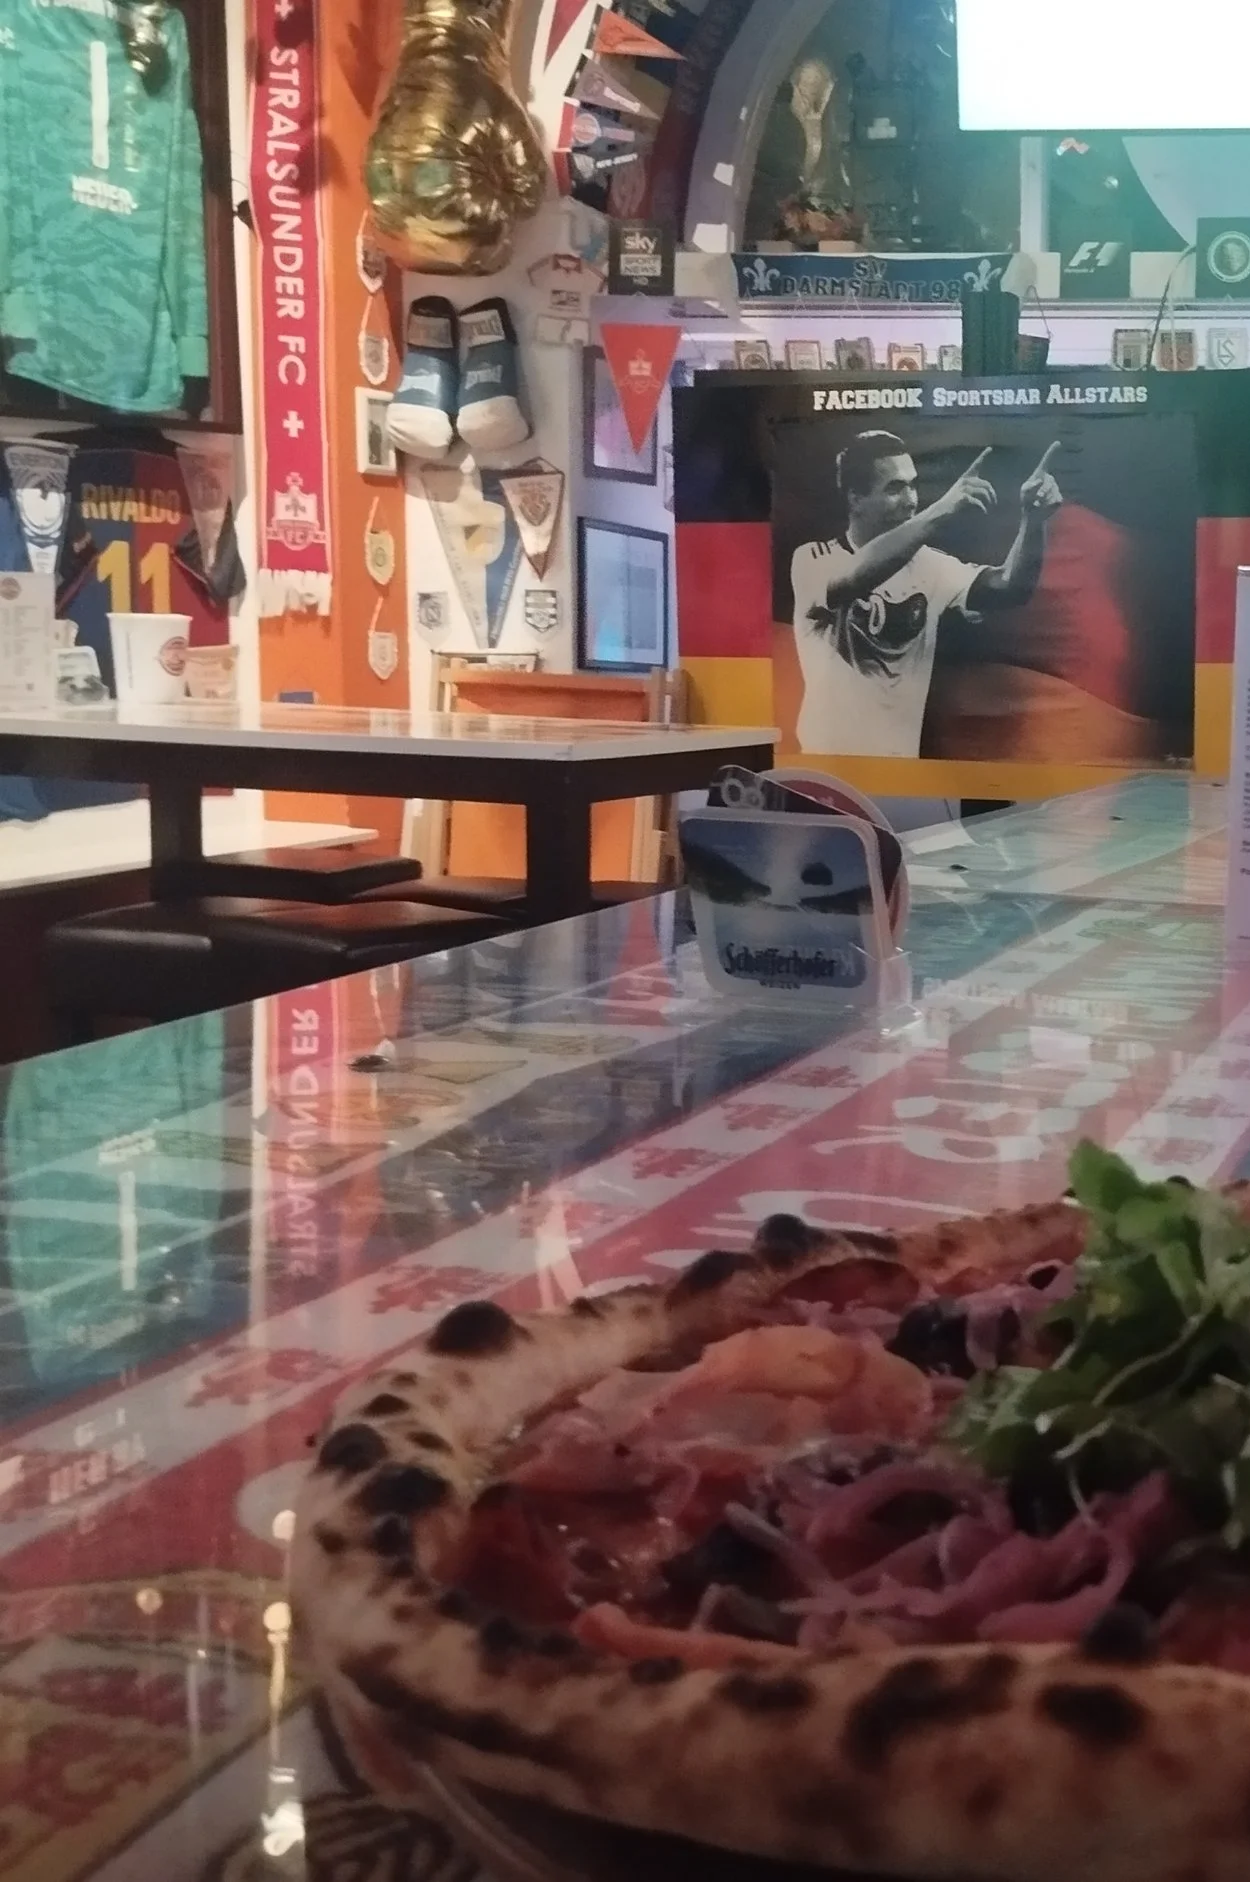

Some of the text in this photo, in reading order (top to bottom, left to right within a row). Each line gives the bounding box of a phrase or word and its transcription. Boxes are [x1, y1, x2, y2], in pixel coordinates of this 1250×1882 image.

[269, 47, 307, 388] STRALSUNDER FC
[624, 232, 658, 254] sky
[853, 258, 887, 281] SV
[781, 276, 962, 301] DARMSTADT 98
[813, 382, 1148, 411] FACEBOOK SPORTSBAR ALLSTARS
[80, 483, 182, 525] RIVALDO
[97, 540, 172, 614] 11
